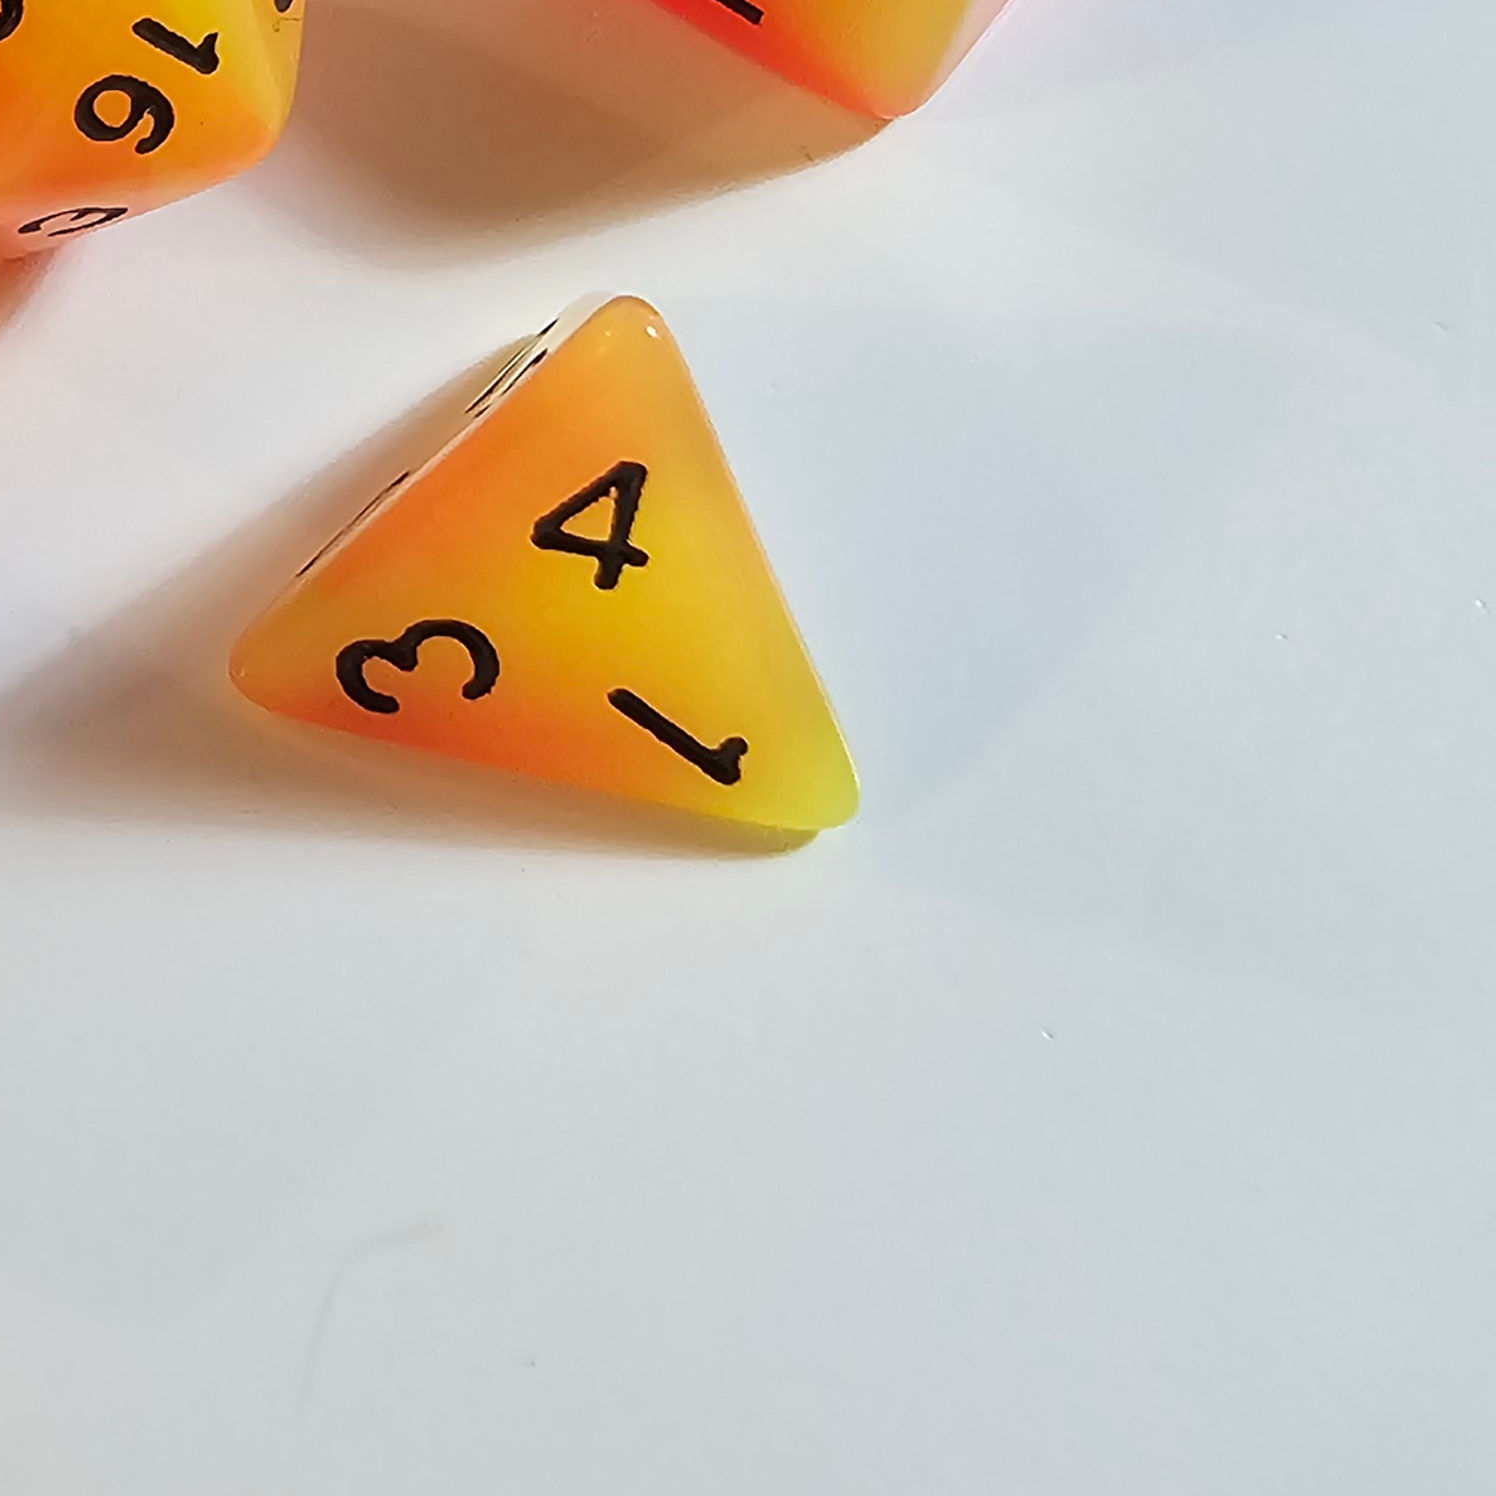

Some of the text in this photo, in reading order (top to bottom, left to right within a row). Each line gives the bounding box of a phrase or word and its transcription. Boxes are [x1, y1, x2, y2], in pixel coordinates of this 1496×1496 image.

[73, 16, 221, 156] 16
[530, 460, 650, 591] 4
[335, 618, 501, 716] 3
[606, 687, 750, 787] 1
